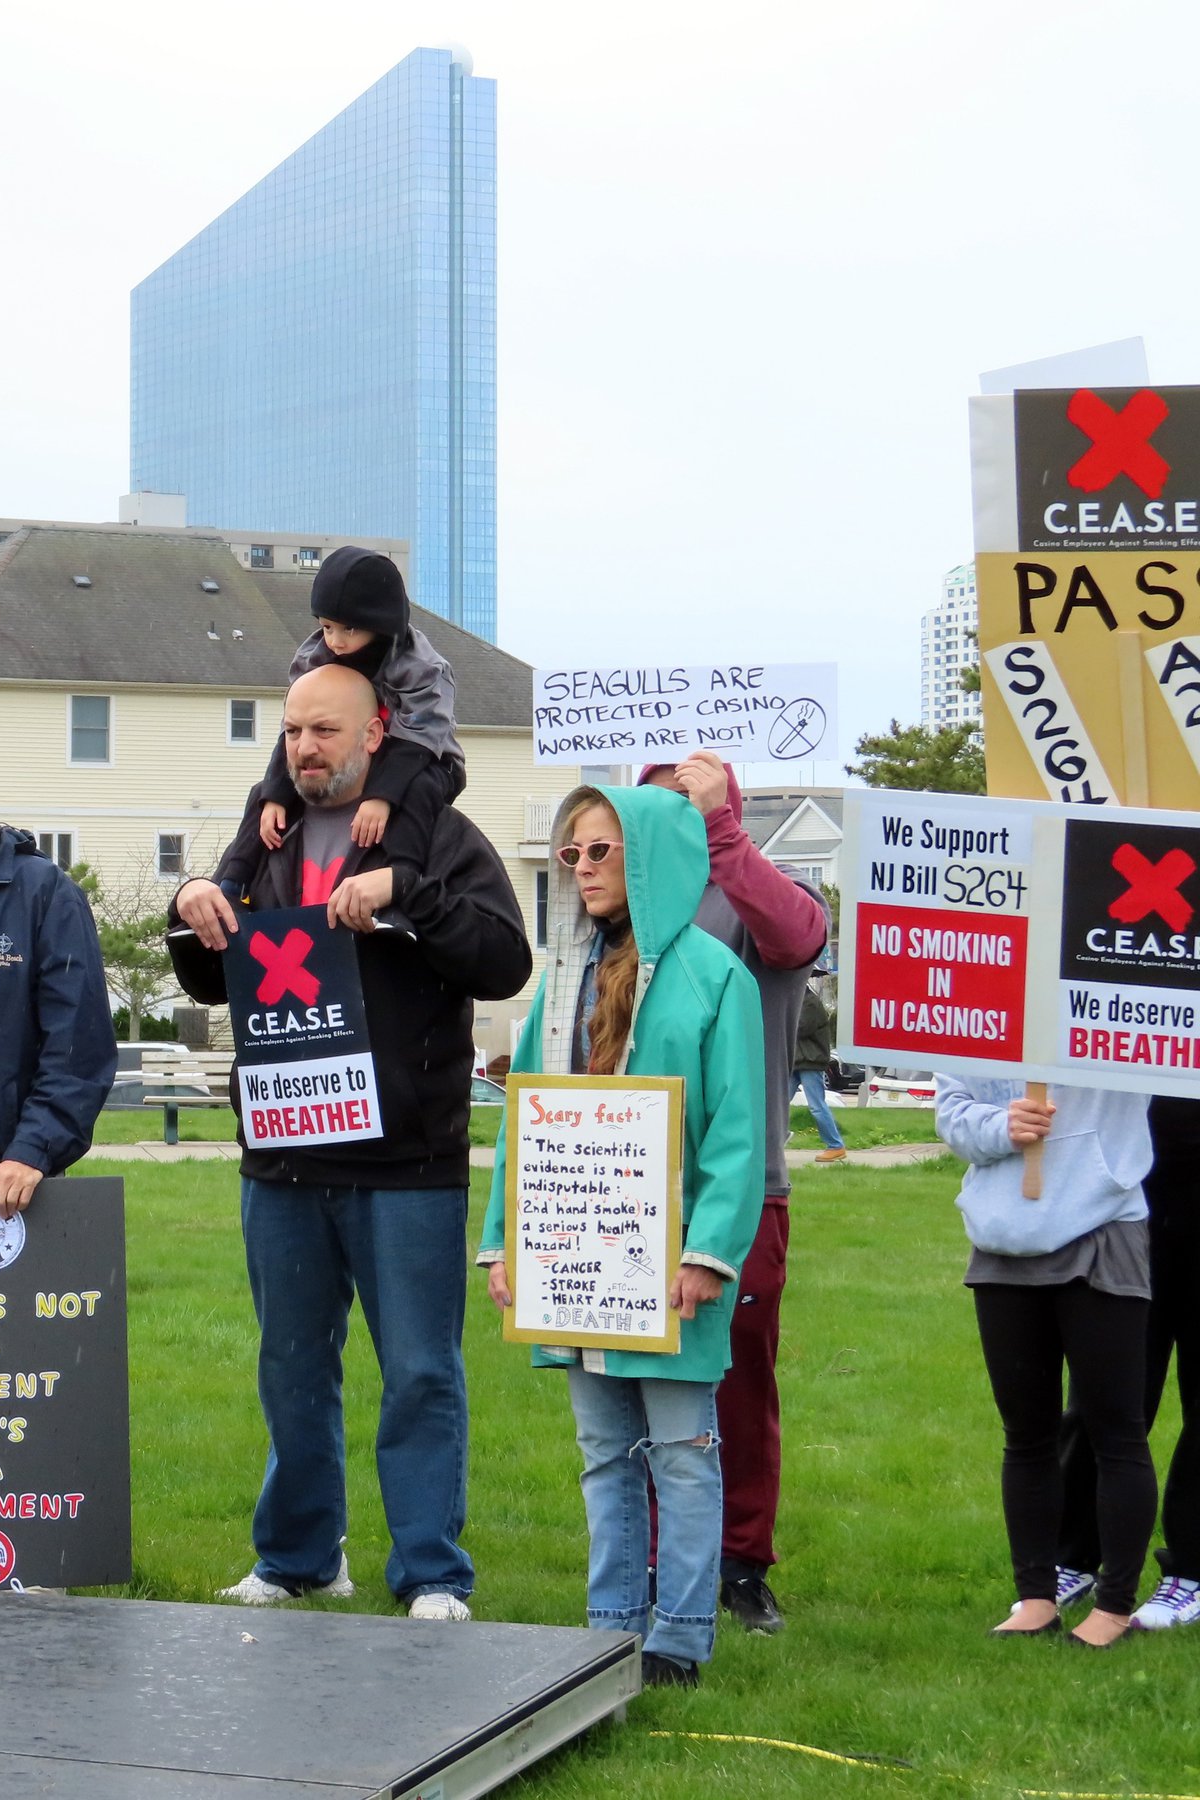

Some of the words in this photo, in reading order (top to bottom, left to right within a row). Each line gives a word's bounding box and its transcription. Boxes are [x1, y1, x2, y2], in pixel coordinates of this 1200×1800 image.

[1044, 502, 1199, 534] C.E.A.S.E
[1033, 539, 1061, 547] Casino
[1063, 539, 1106, 548] Employees
[1108, 539, 1140, 548] Against
[1143, 538, 1178, 548] Smoking
[1181, 538, 1200, 546] Effe
[1013, 561, 1200, 634] PAS
[544, 668, 690, 701] SEAGULLS
[711, 667, 764, 691] ARE
[696, 696, 786, 716] CASINO
[538, 732, 636, 756] WORKERS
[644, 728, 688, 748] ARE
[699, 720, 755, 744] NOT!
[882, 815, 913, 847] We
[920, 819, 1010, 859] Support
[871, 861, 895, 892] NJ
[902, 863, 937, 896] Bill
[943, 864, 1028, 910] S264
[871, 923, 901, 957] NO
[907, 927, 1011, 967] SMOKING
[1076, 954, 1099, 962] Casino
[1101, 956, 1136, 965] Employees
[1138, 959, 1163, 967] Against
[1166, 962, 1195, 970] Smoking
[927, 967, 951, 999] IN
[248, 1003, 345, 1037] C.E.A.S.E
[870, 998, 895, 1030] NJ
[901, 1001, 1007, 1042] CASINOS!
[1069, 989, 1100, 1020] We
[1108, 993, 1195, 1028] deserve
[285, 1036, 306, 1044] Against
[307, 1033, 332, 1041] Smoking
[246, 1074, 269, 1102] We
[273, 1070, 341, 1100] deserve
[345, 1066, 367, 1092] to
[251, 1098, 372, 1140] BREATHE!
[529, 1094, 582, 1127] Scary
[573, 1141, 646, 1157] scientific
[524, 1160, 585, 1174] evidence
[593, 1163, 605, 1175] is
[556, 1201, 587, 1215] hand
[644, 1202, 657, 1216] is
[522, 1221, 531, 1232] a
[539, 1220, 587, 1233] serious
[597, 1220, 641, 1235] health
[35, 1291, 102, 1318] NOT
[555, 1307, 632, 1332] DEATH
[599, 1296, 657, 1311] ATTACKS
